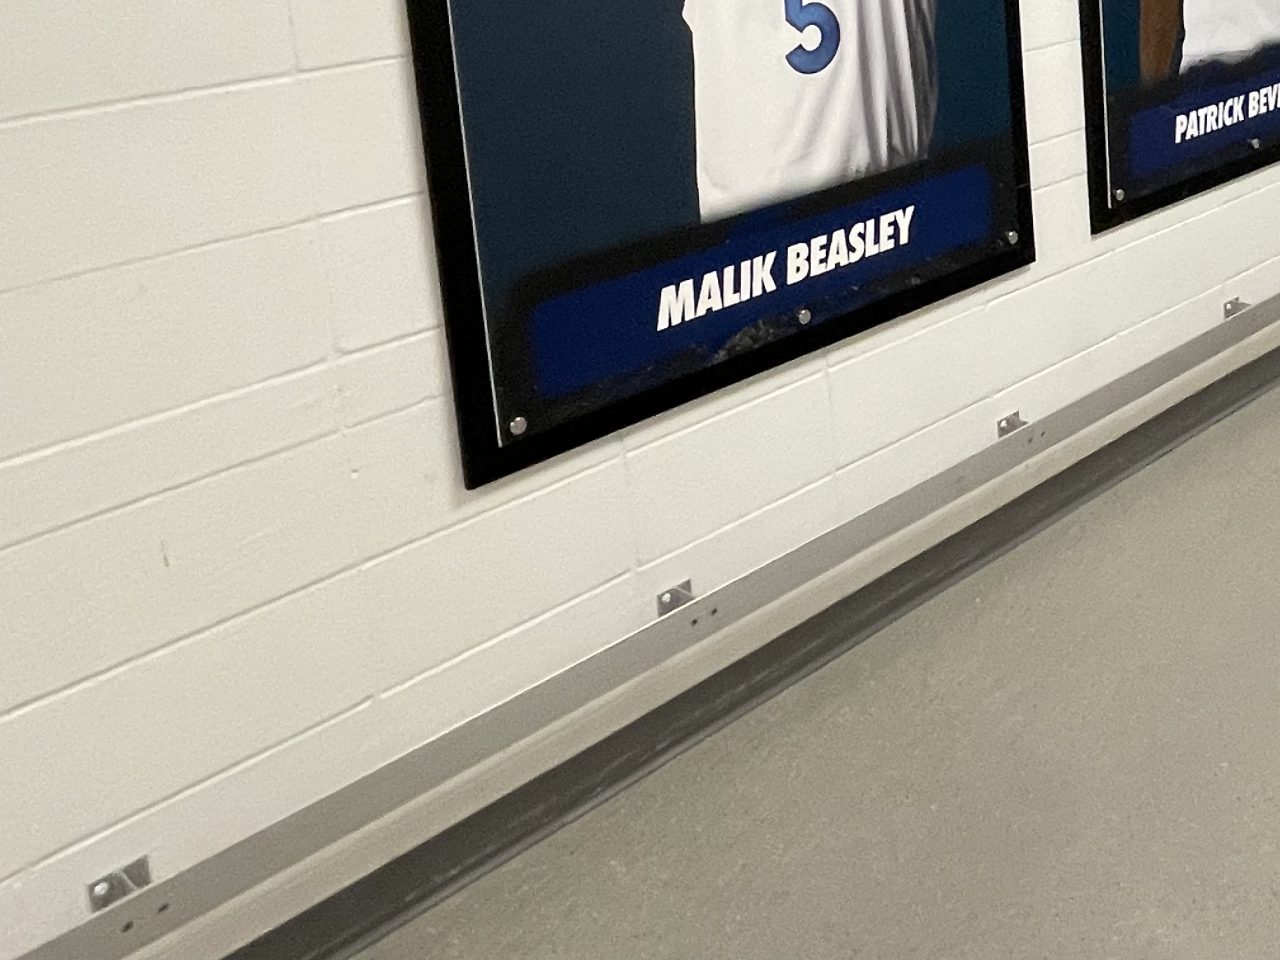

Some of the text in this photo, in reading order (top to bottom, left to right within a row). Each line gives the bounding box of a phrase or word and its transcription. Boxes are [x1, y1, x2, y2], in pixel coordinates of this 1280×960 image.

[1174, 94, 1246, 144] PATRICK
[656, 205, 915, 332] MALIK BEASLEY
